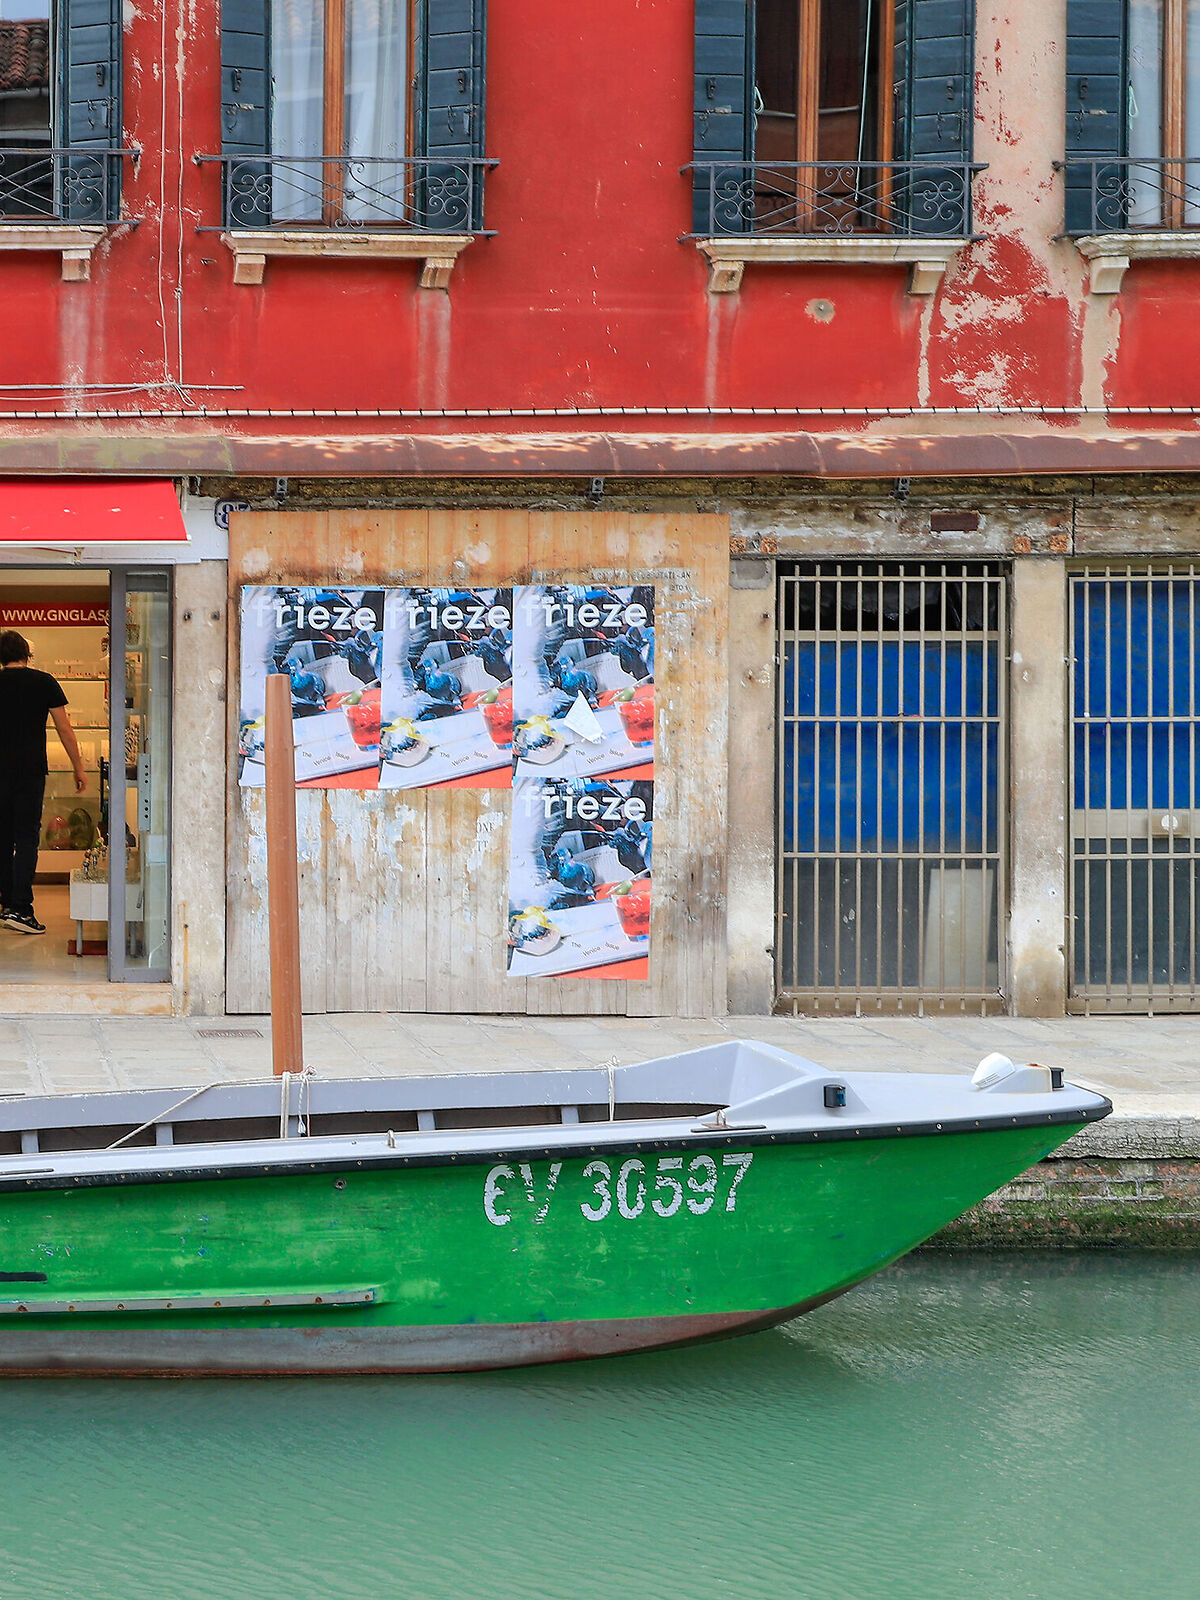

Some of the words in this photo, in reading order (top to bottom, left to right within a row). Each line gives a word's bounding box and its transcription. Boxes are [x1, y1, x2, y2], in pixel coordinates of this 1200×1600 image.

[252, 596, 377, 631] frieze
[385, 596, 511, 630] frieze
[520, 594, 648, 628] frieze
[520, 785, 647, 820] frieze
[580, 1152, 754, 1222] 30597
